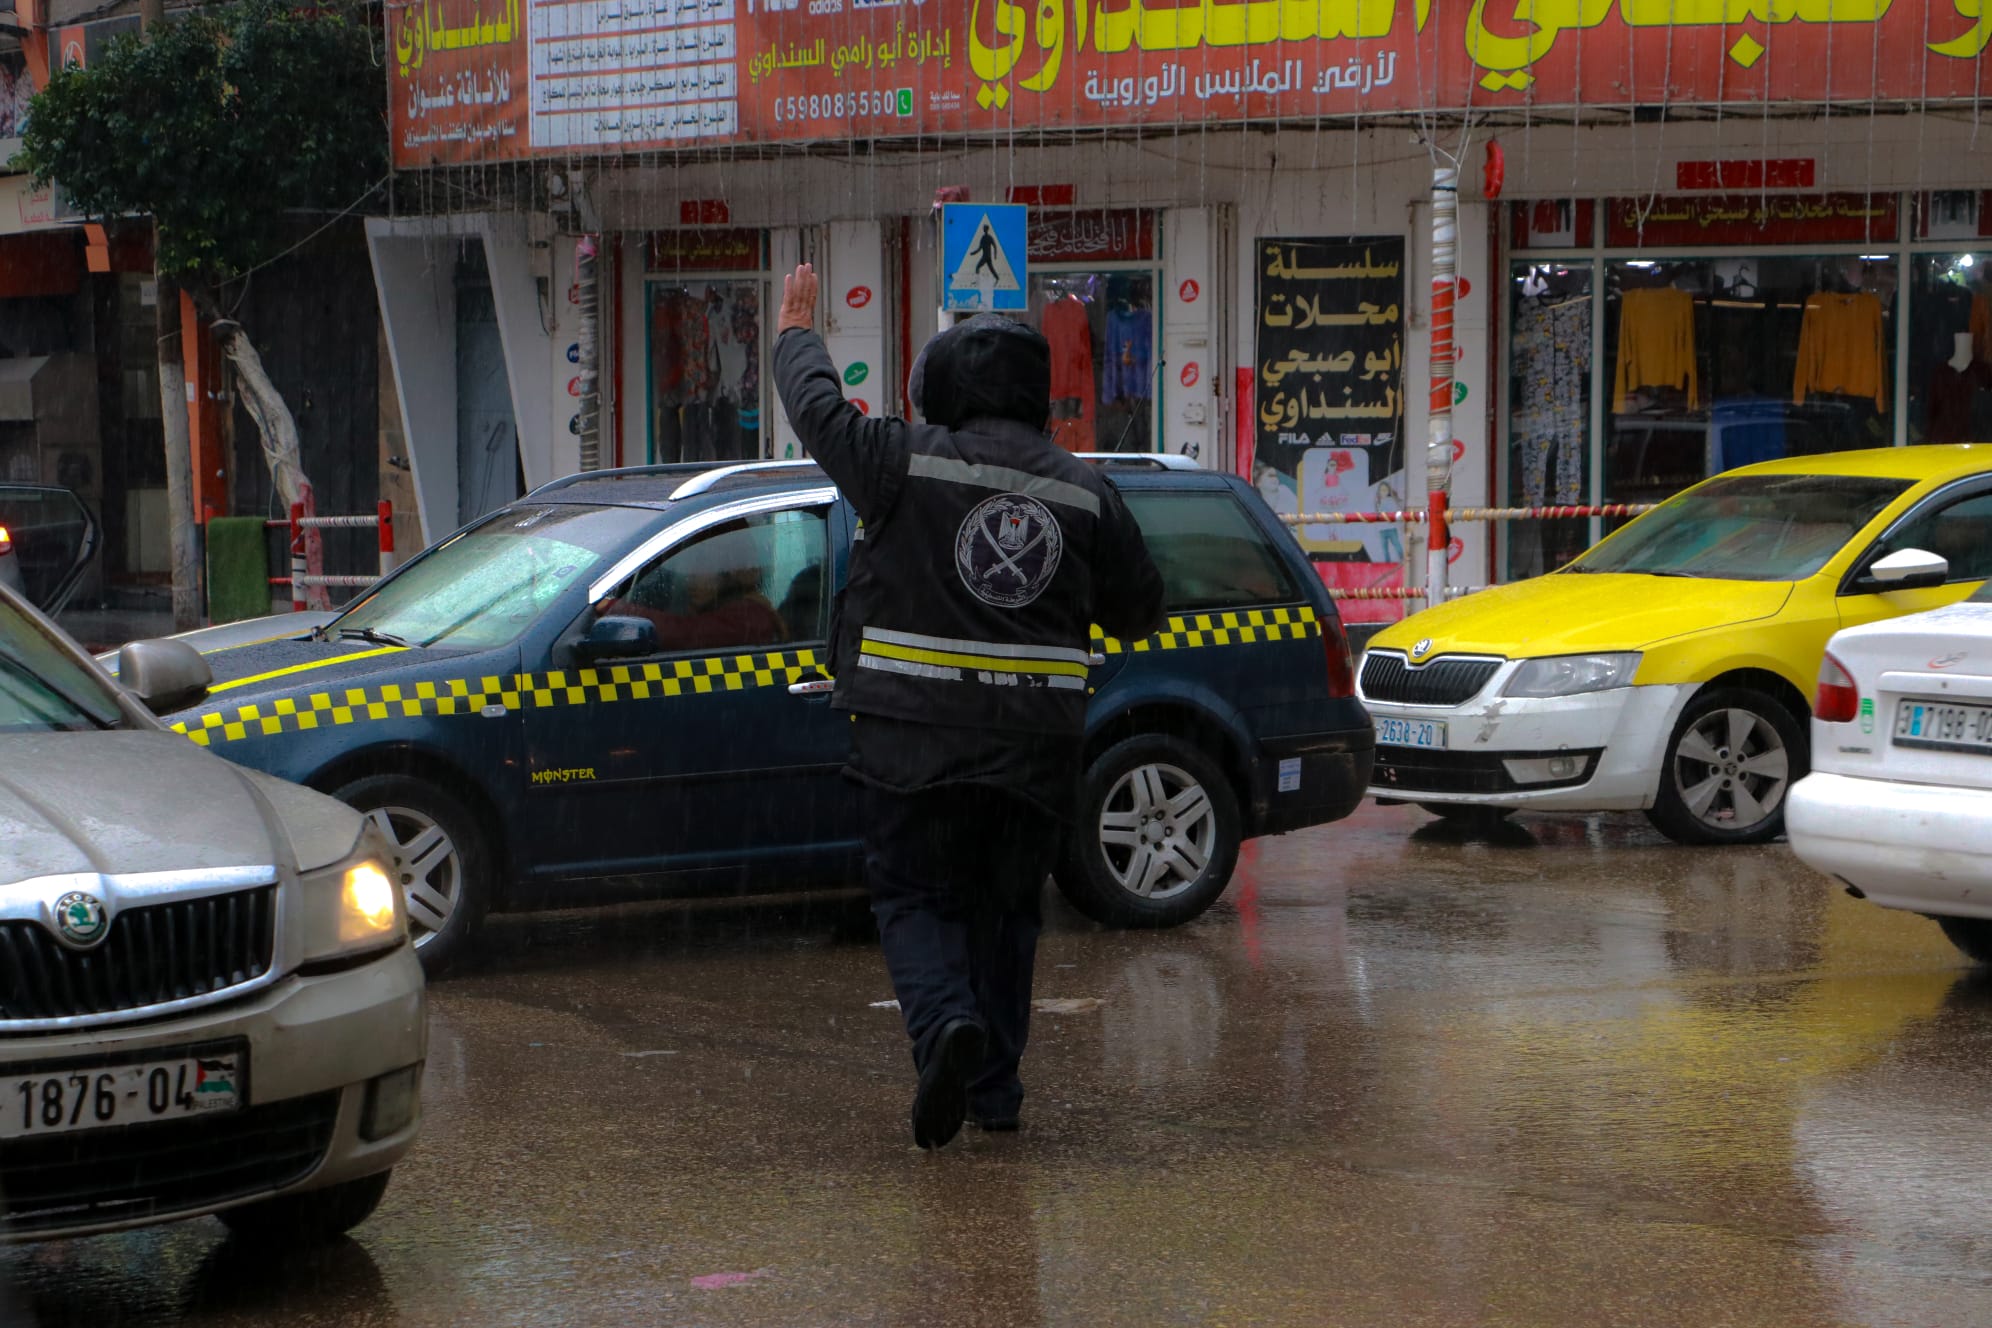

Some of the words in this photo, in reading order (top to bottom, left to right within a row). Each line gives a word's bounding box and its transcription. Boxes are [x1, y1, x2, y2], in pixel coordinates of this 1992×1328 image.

[749, 38, 825, 84] السنداوي
[831, 34, 873, 78] رامي
[878, 21, 903, 68] أبو
[908, 28, 950, 68] إدارة
[1084, 61, 1186, 107] الأوروبية
[1194, 58, 1302, 102] الملابس
[1265, 245, 1399, 279] سلسلة
[1264, 292, 1399, 329] محلات
[1262, 348, 1356, 387] صبحي
[1359, 332, 1400, 382] أبو
[1260, 384, 1404, 432] السنداوي
[1278, 432, 1311, 446] FILA
[531, 768, 597, 784] MONSTER
